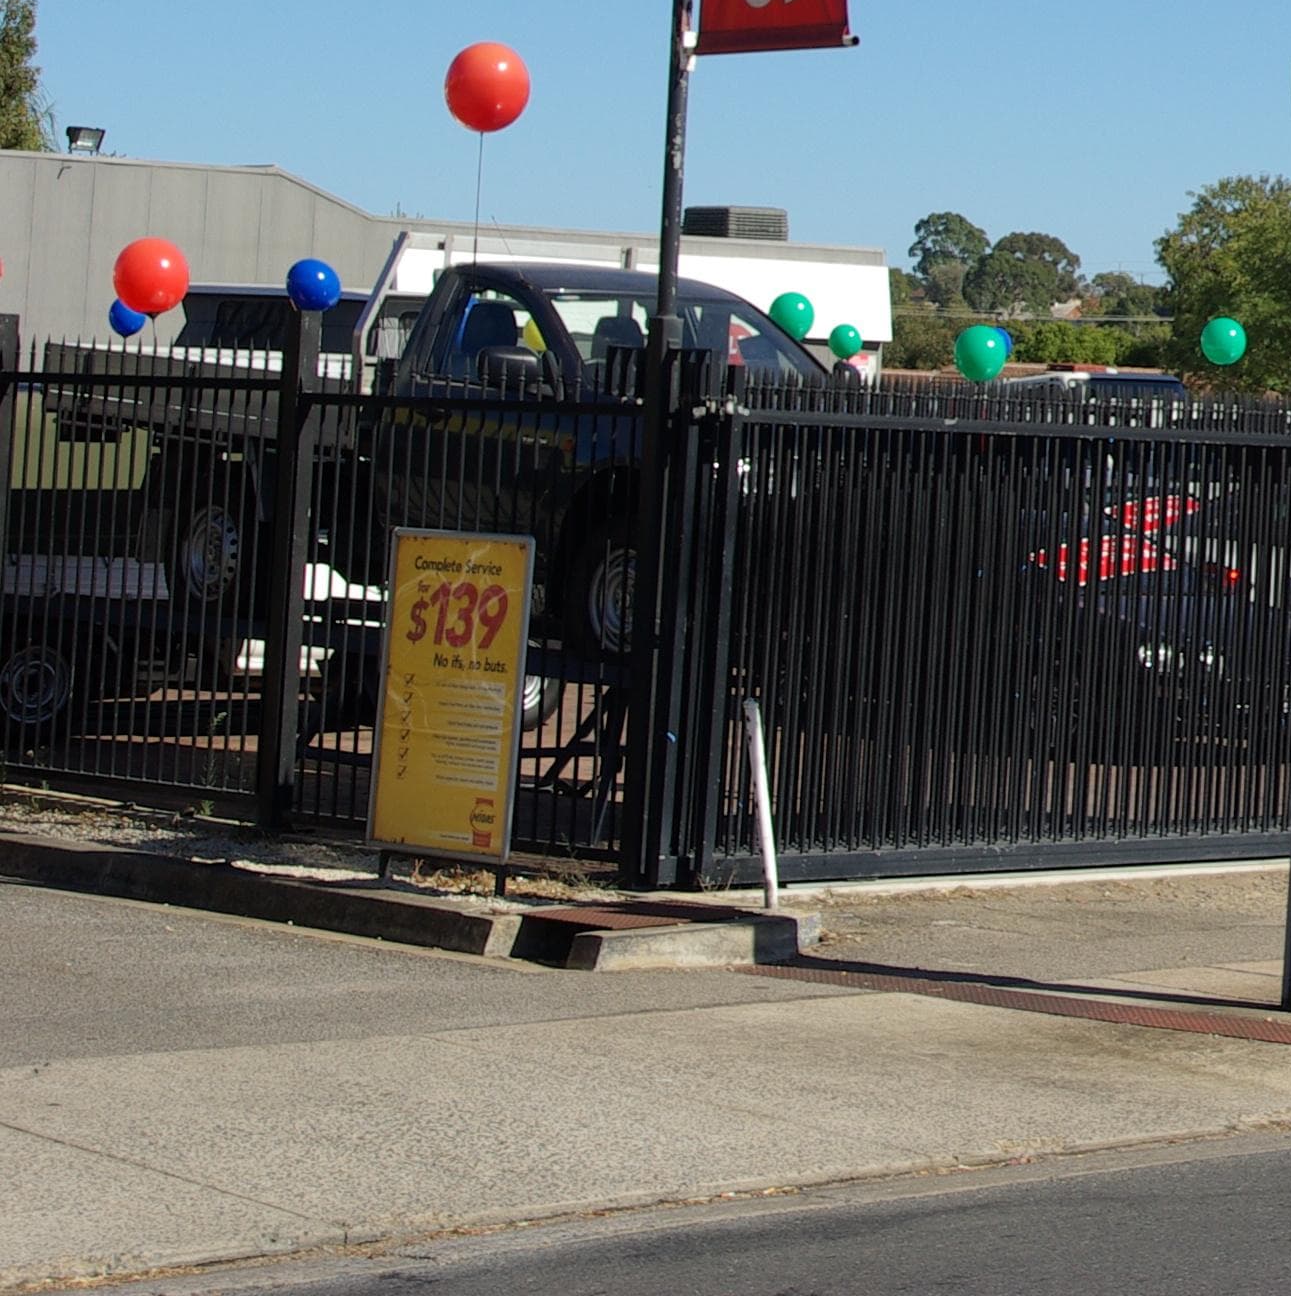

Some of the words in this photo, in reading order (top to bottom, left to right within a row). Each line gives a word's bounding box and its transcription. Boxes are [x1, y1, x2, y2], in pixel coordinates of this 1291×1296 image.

[415, 556, 463, 575] Complete
[466, 560, 502, 576] Service
[406, 581, 509, 650] $139
[433, 653, 448, 668] No
